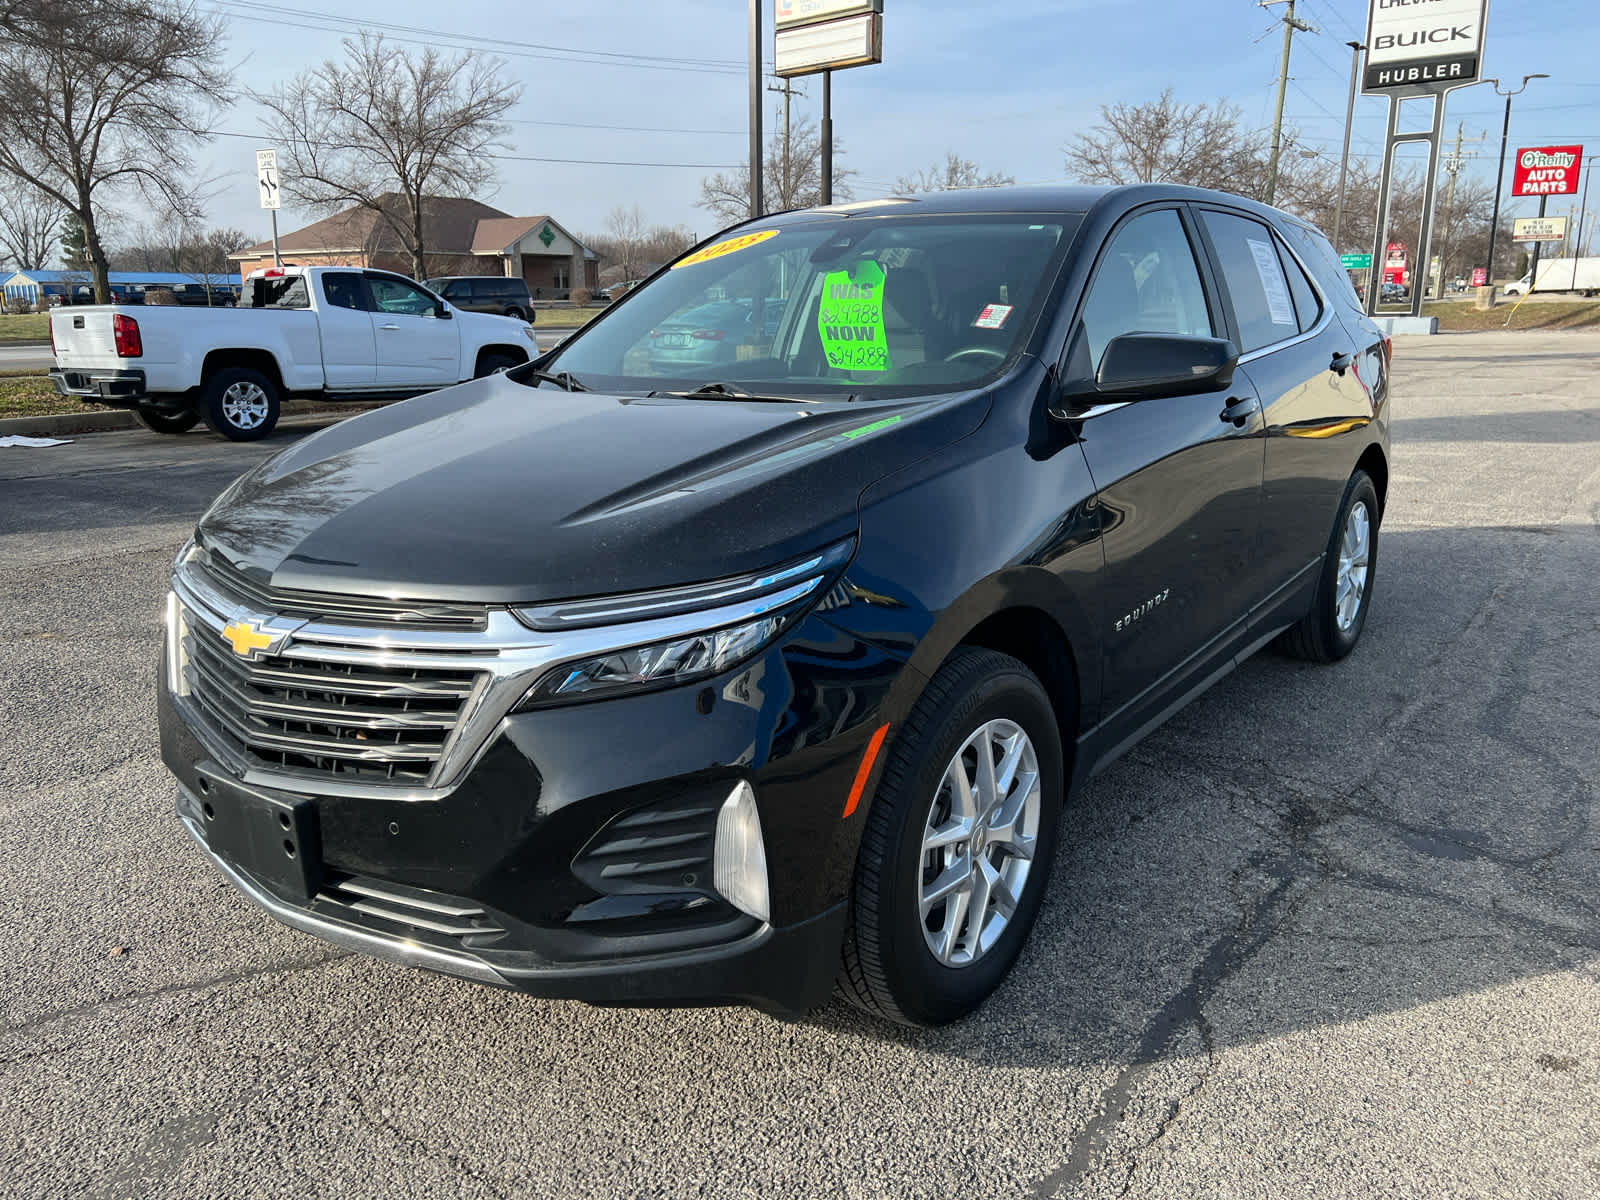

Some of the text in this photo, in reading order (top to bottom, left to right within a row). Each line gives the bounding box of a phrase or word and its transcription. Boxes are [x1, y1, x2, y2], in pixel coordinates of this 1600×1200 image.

[1374, 24, 1472, 50] BUICK
[1379, 63, 1461, 84] HUBLER
[1520, 151, 1576, 169] O'Reilly
[1527, 168, 1566, 181] AUTO
[1521, 180, 1567, 193] PARTS
[829, 282, 874, 300] WAS
[824, 325, 876, 342] NOW
[1115, 588, 1169, 632] EQUINOX
